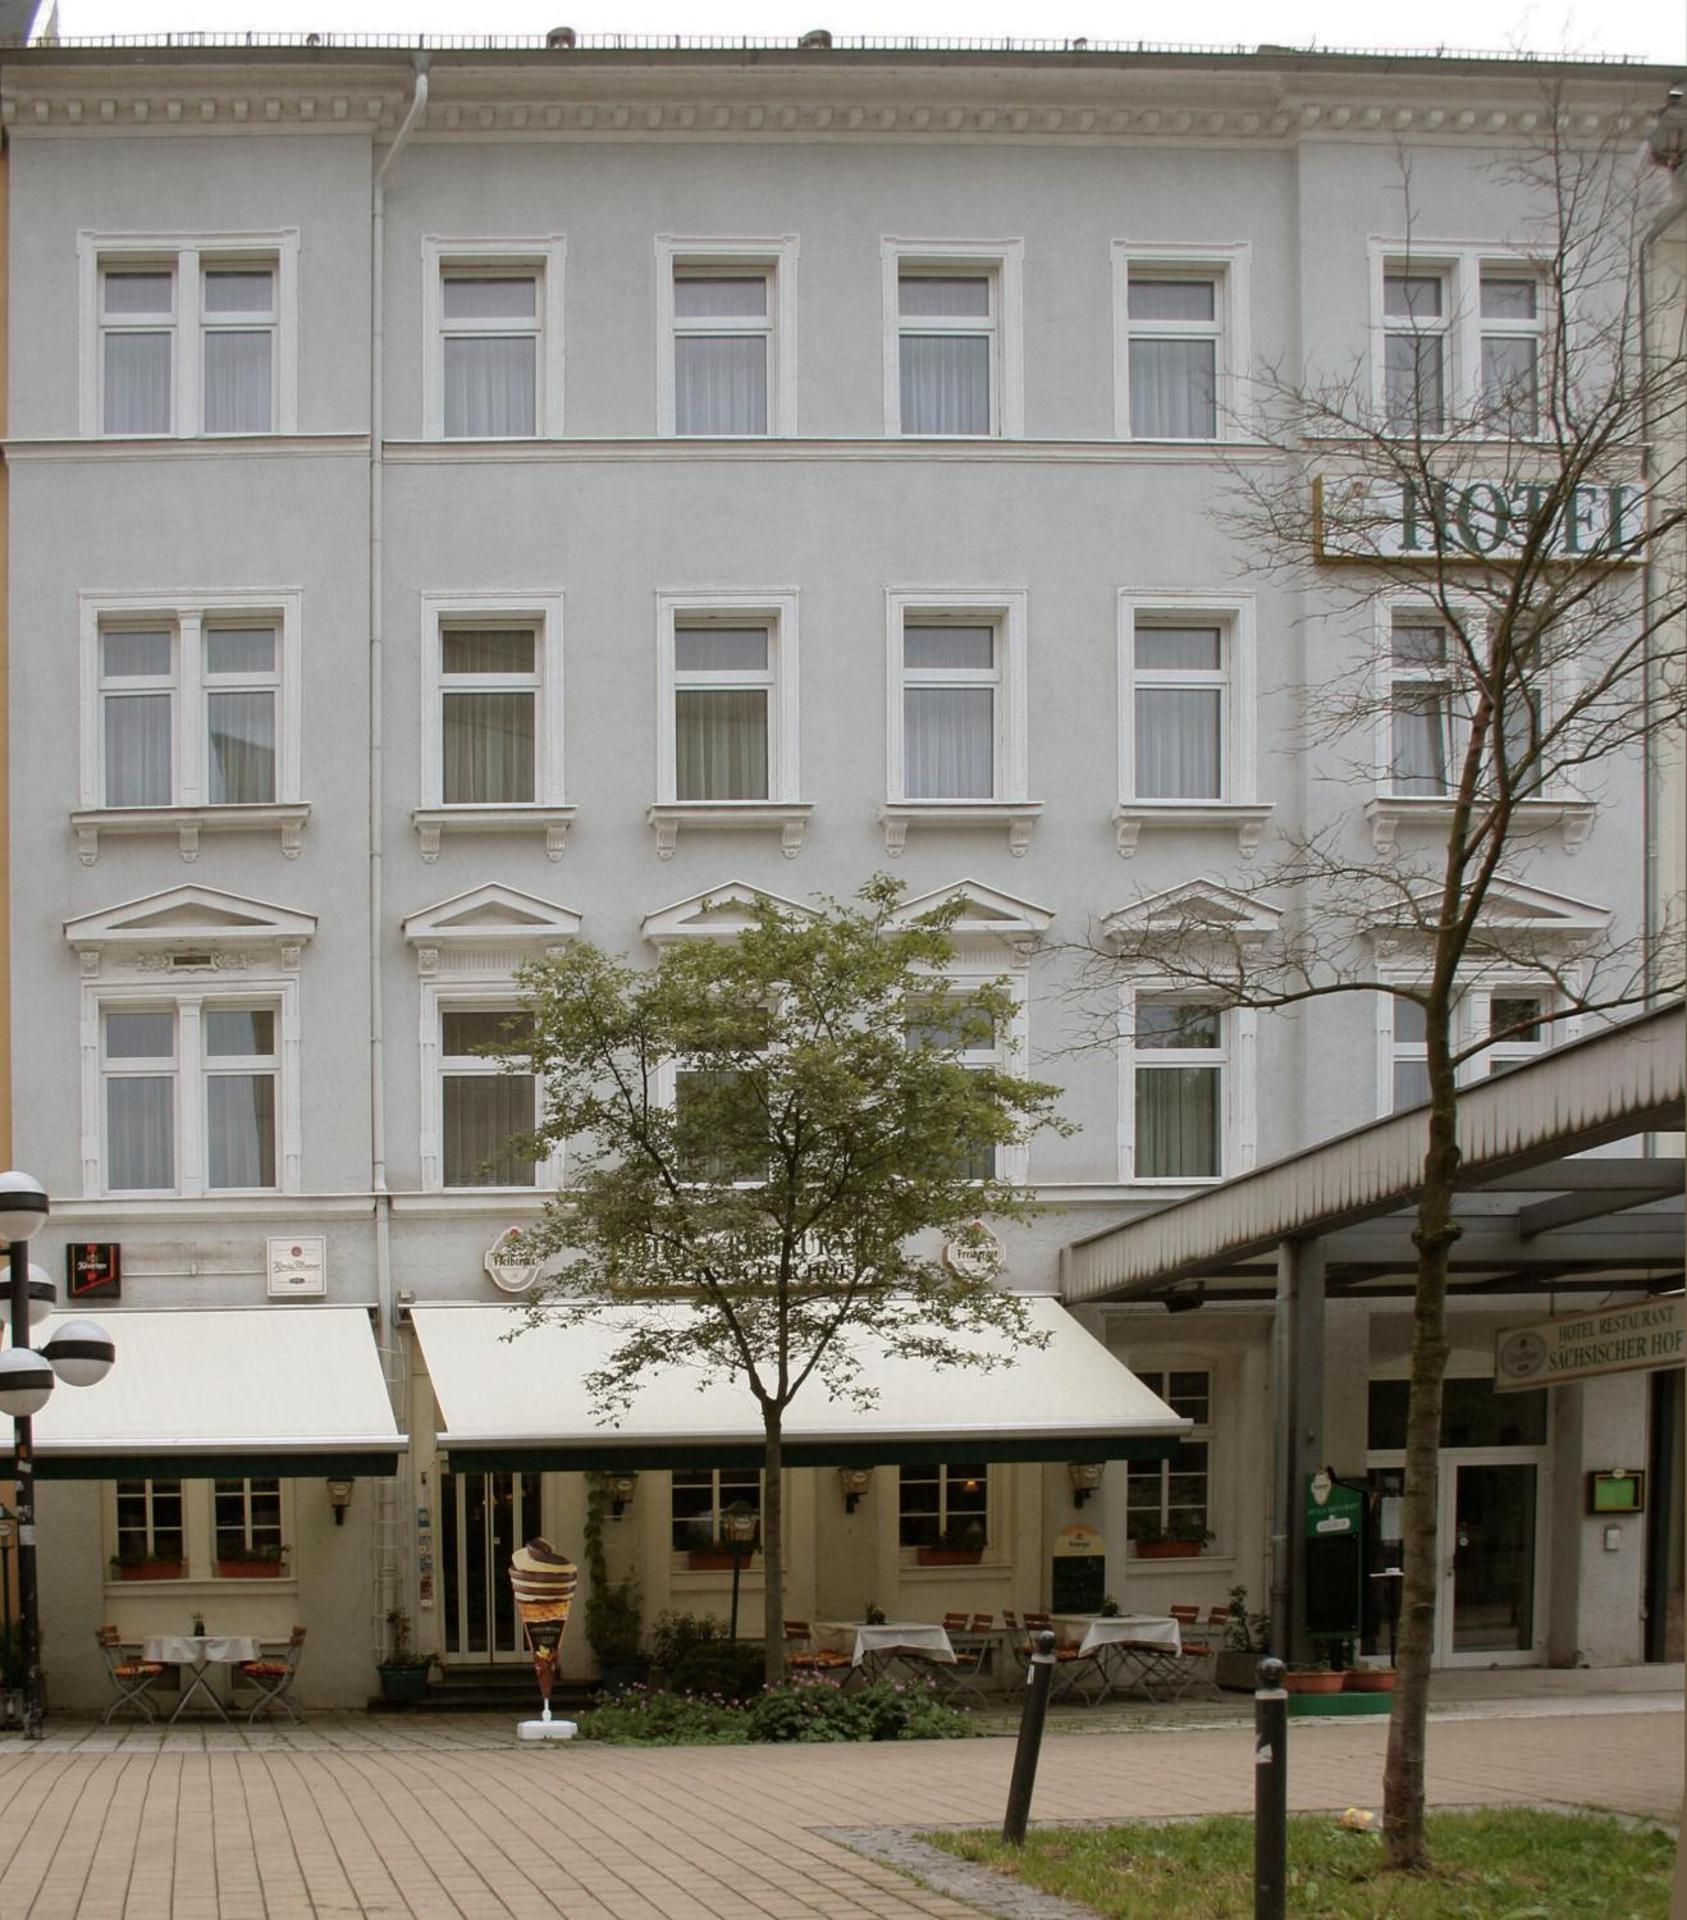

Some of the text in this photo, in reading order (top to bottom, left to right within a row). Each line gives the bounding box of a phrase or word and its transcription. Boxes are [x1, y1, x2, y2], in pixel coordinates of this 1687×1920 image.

[1398, 480, 1643, 556] HOTEL
[1558, 1306, 1675, 1343] HOTEL RESTAURANT
[1550, 1330, 1684, 1371] SÄCHSISCHER HOF
